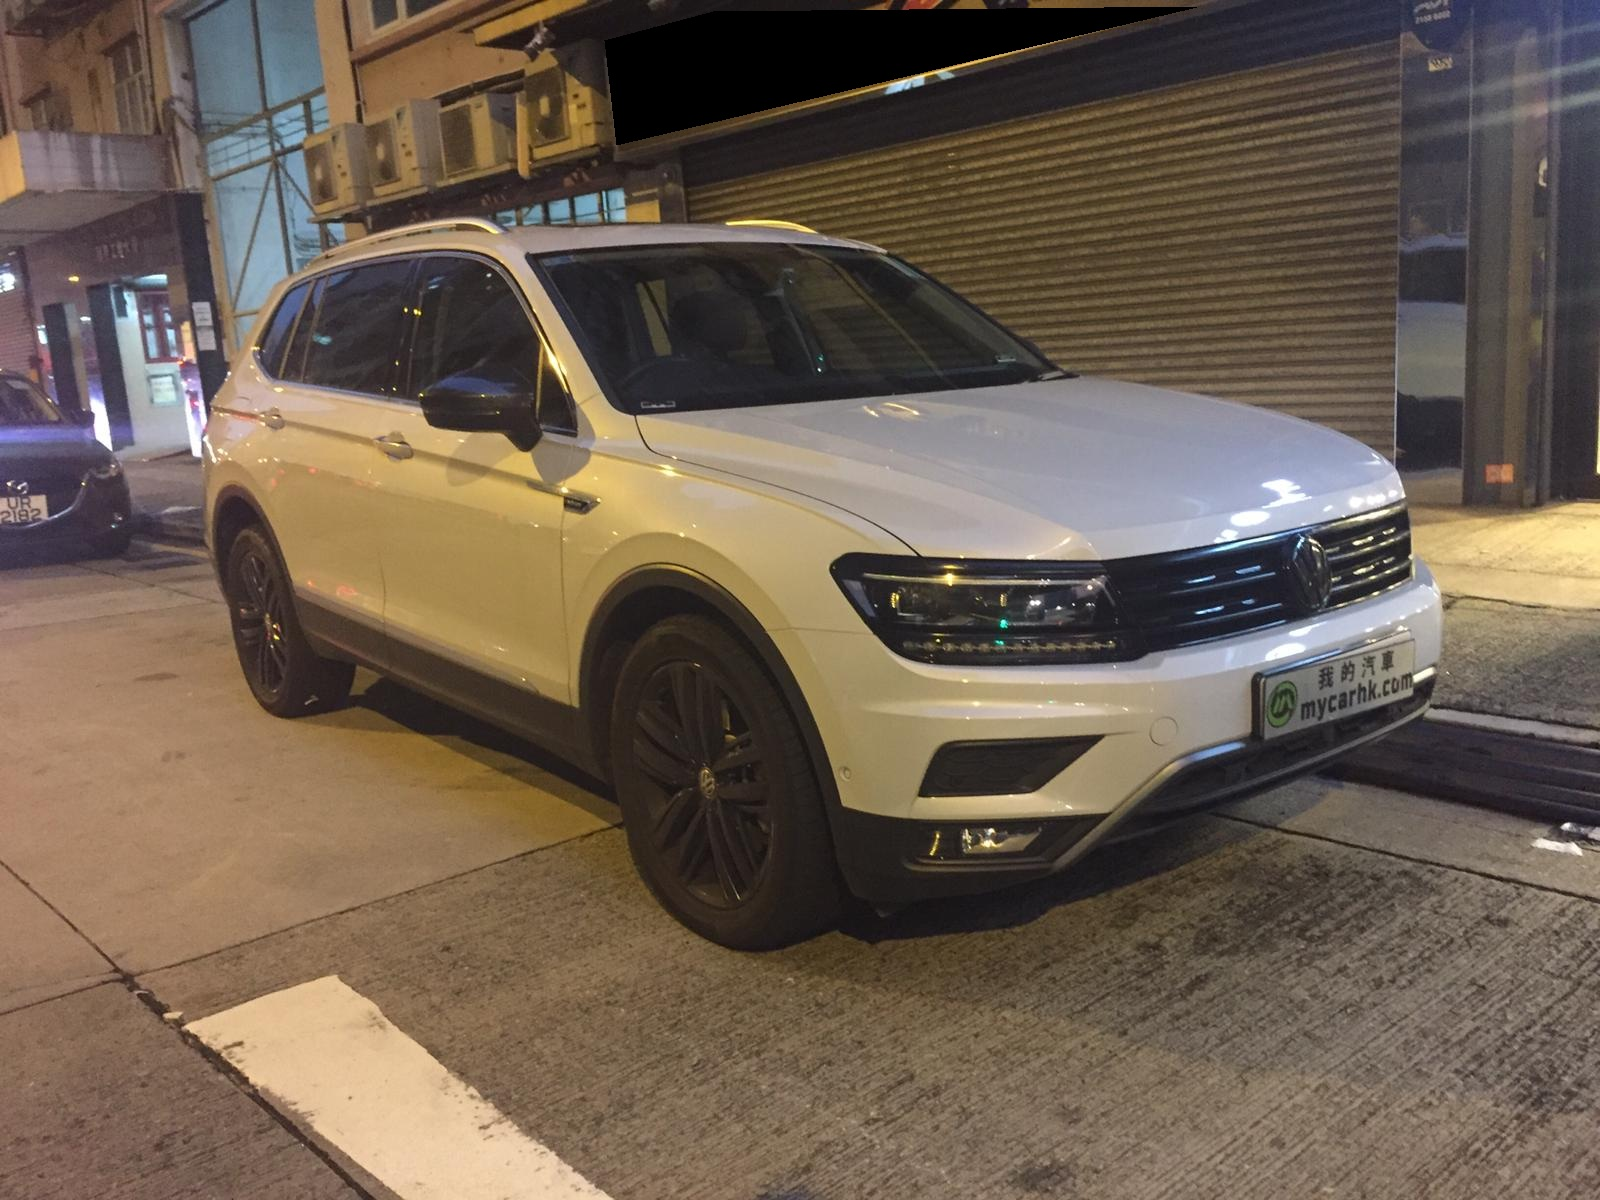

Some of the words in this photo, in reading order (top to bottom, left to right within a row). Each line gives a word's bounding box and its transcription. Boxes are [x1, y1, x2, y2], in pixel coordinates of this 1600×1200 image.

[0, 508, 41, 523] 2182
[7, 496, 31, 509] UR
[1318, 650, 1394, 690] 我的汽車
[1300, 672, 1413, 721] mycarhk.com
